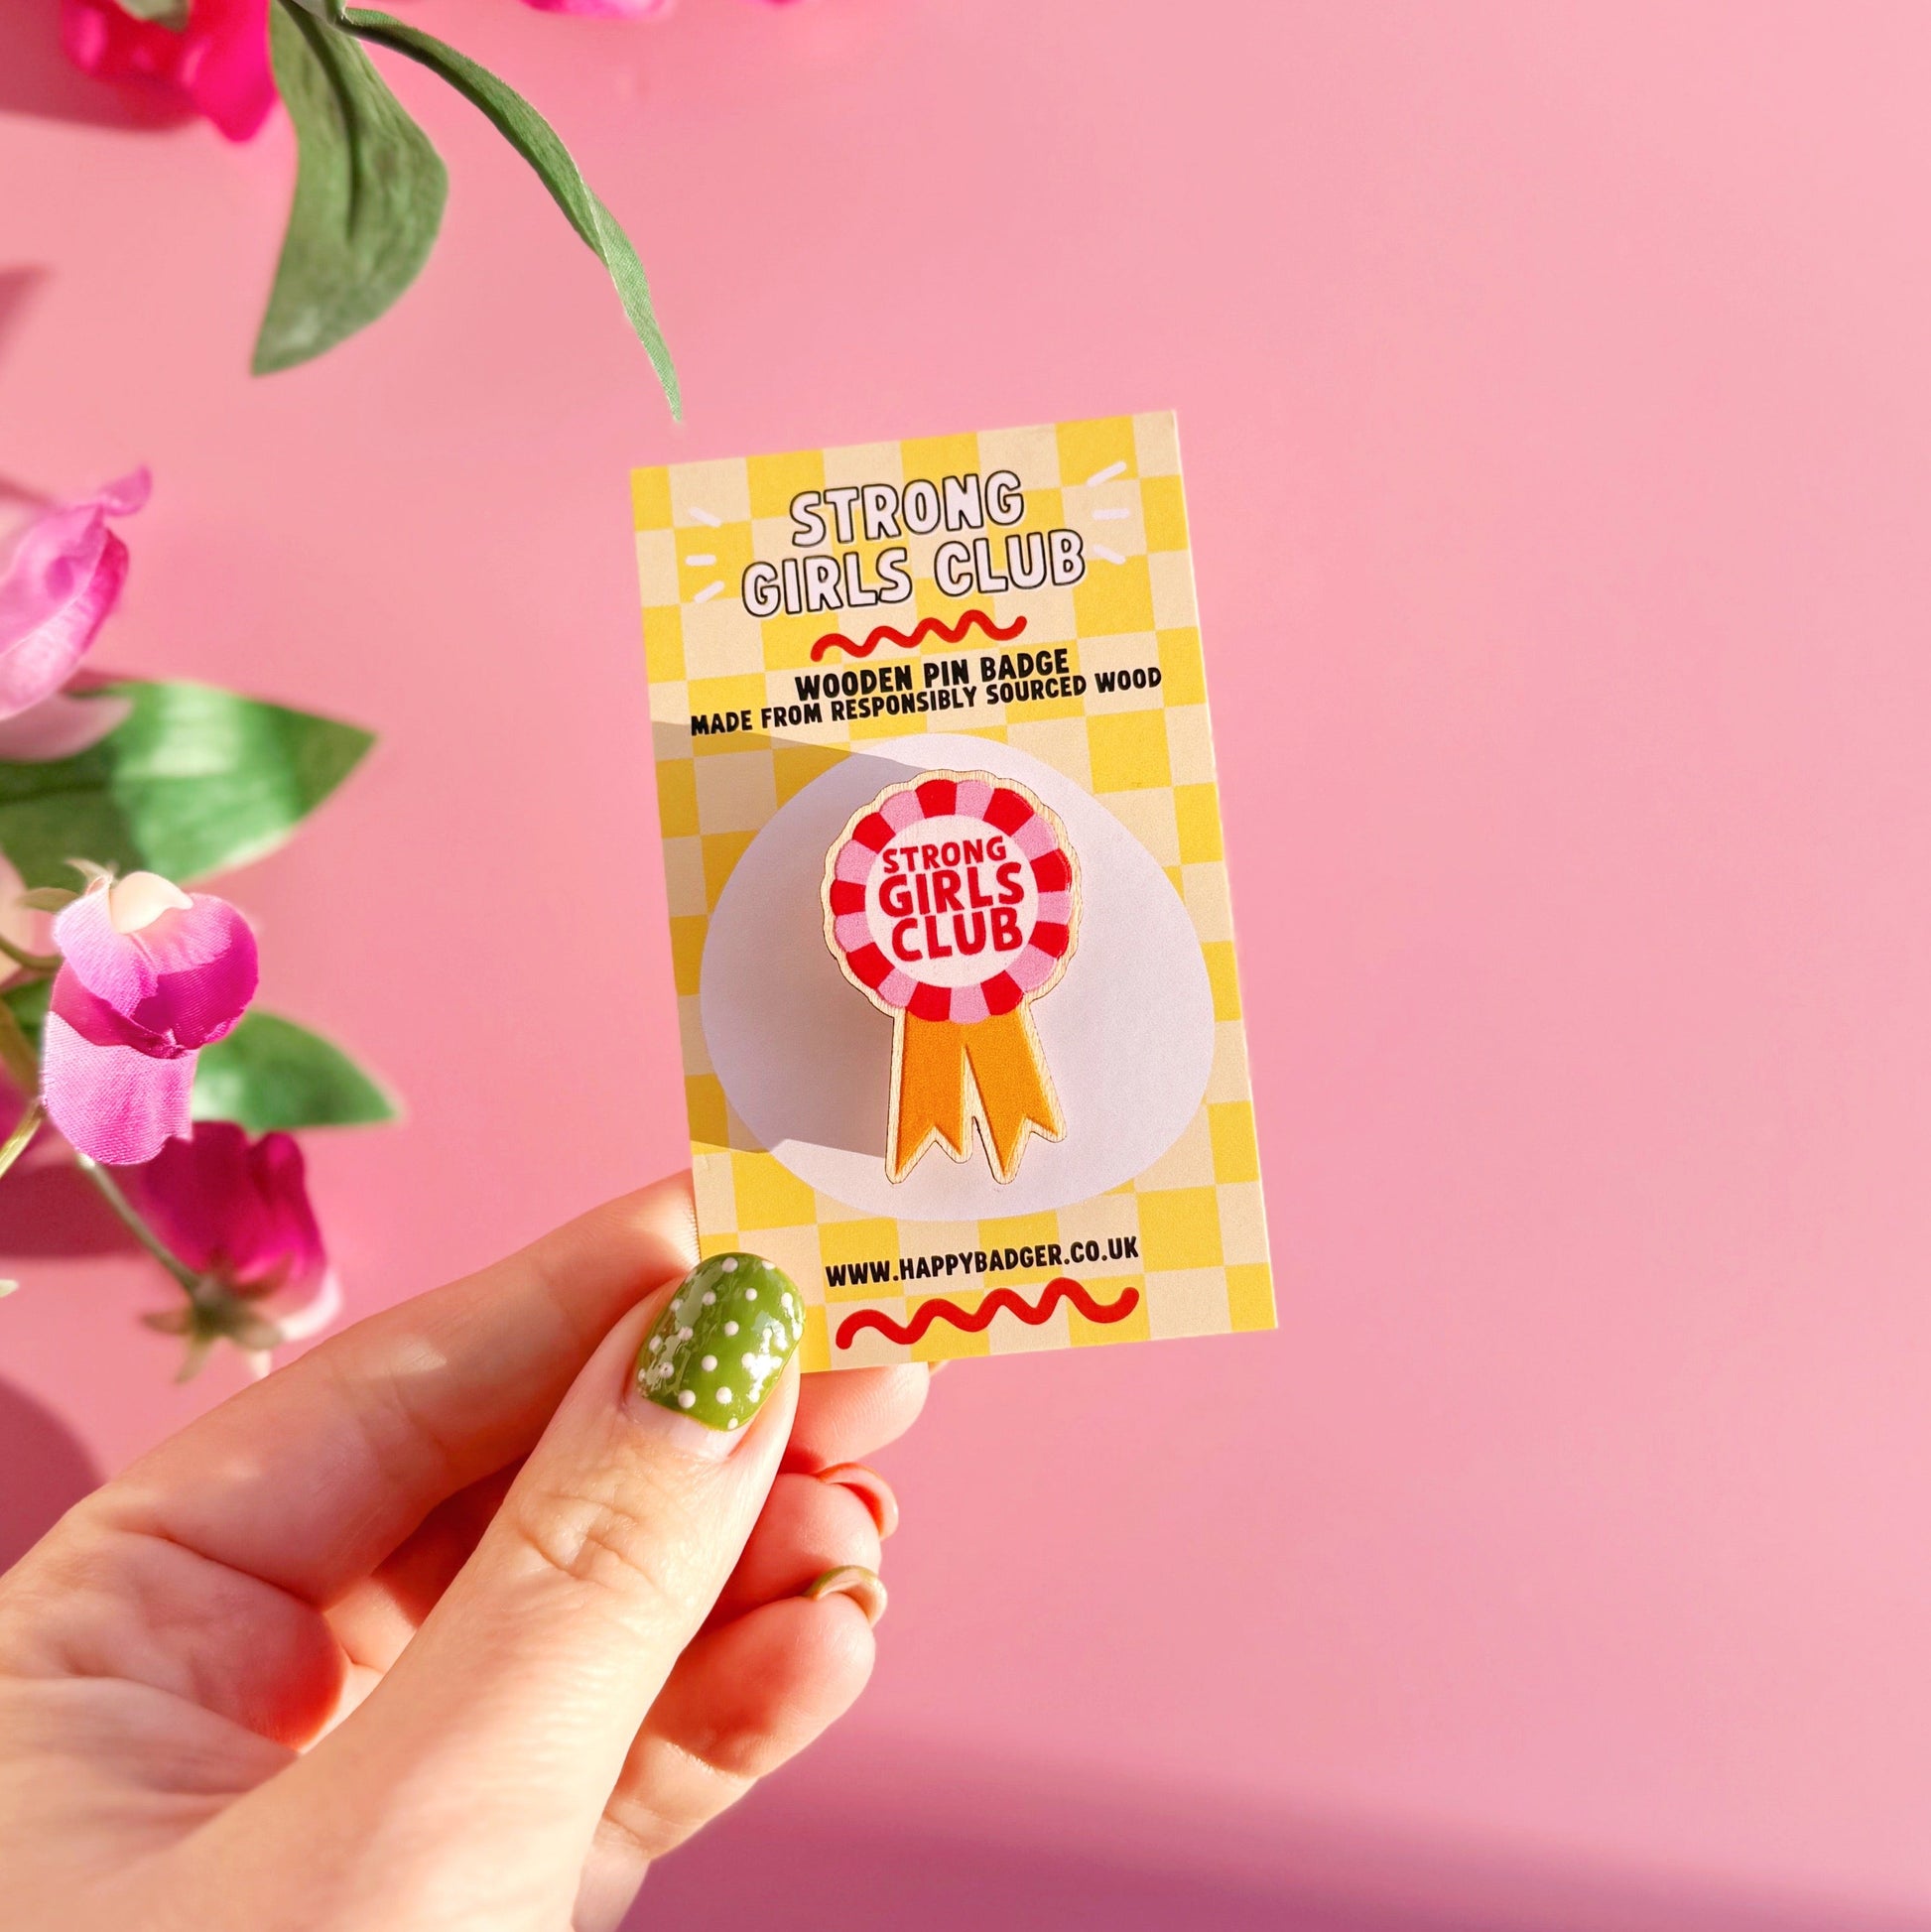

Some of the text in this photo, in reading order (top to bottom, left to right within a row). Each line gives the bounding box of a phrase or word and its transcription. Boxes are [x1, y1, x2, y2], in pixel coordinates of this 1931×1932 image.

[789, 470, 1024, 547] STRONG
[741, 529, 1086, 617] GIRLS CLUB
[691, 666, 1162, 736] MADE FROM RESPONSIBLY SOURCED WOOD
[795, 648, 1070, 702] WOODEN PIN BADGE
[882, 836, 1007, 873] STRONG
[879, 861, 1024, 917] GIRLS
[892, 907, 1023, 962] CLUB
[826, 1236, 1138, 1287] WWW.HAPPYBADGER.CO.UK
